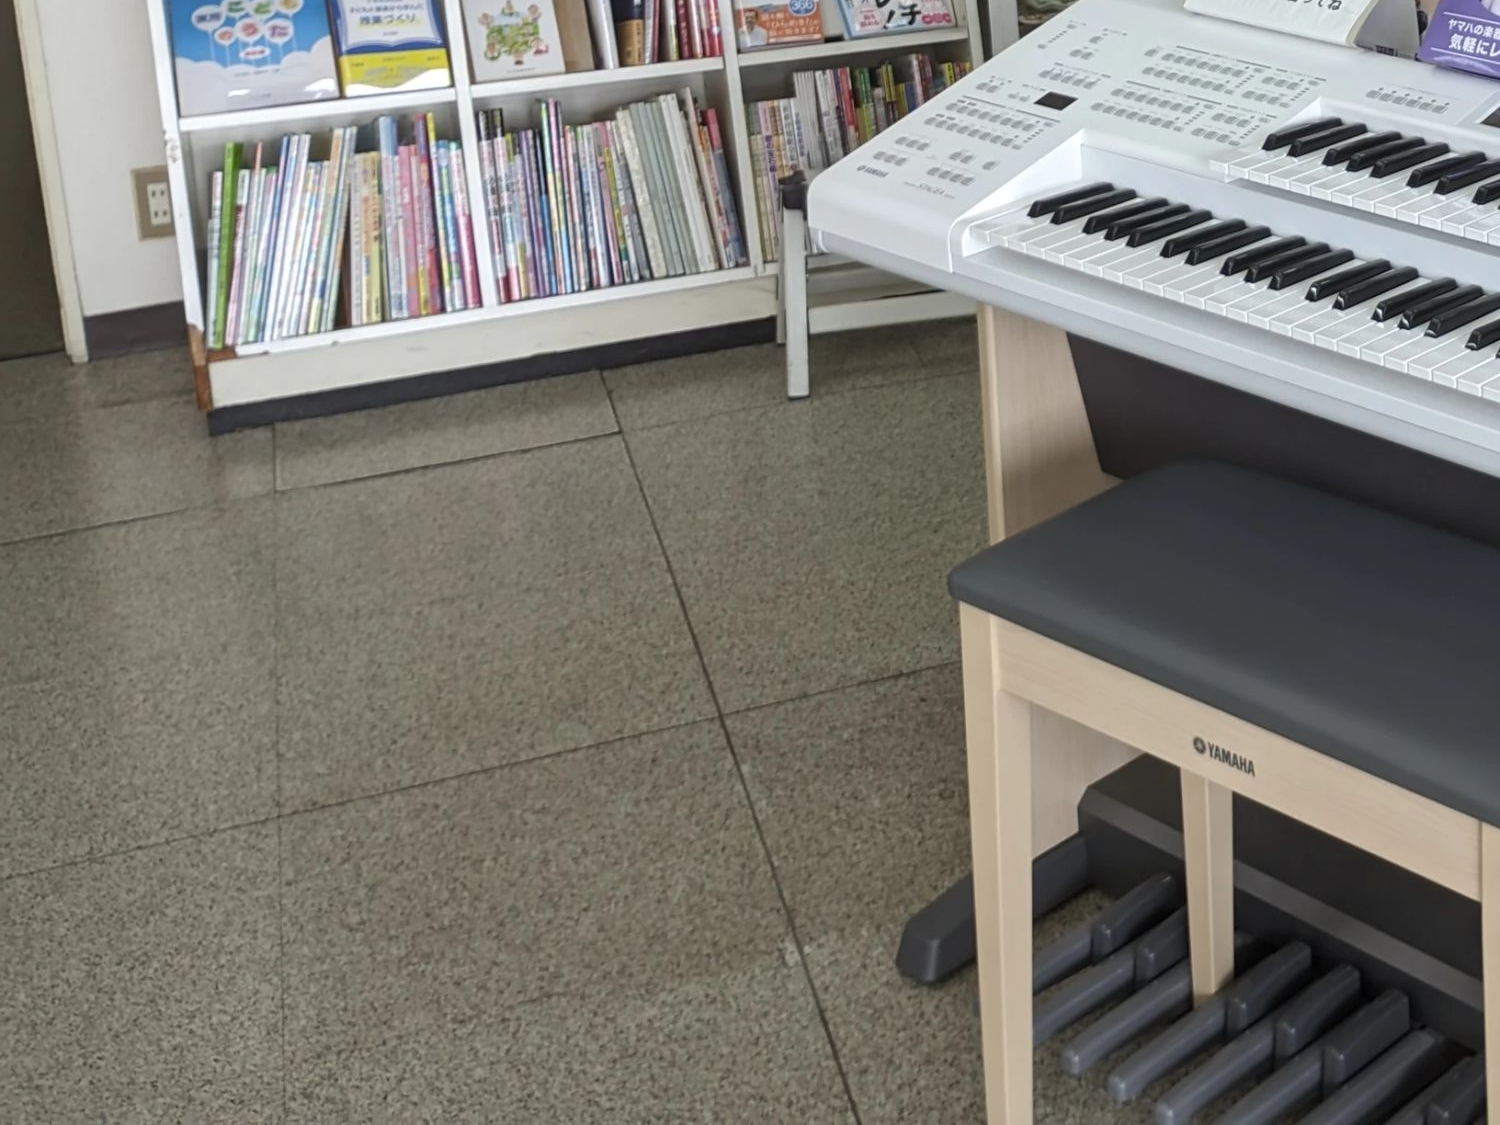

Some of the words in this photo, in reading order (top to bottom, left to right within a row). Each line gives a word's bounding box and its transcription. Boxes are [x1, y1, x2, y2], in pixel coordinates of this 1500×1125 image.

[791, 0, 813, 11] 366
[864, 167, 889, 179] YAMAHA
[1208, 741, 1255, 777] YAMAHA
